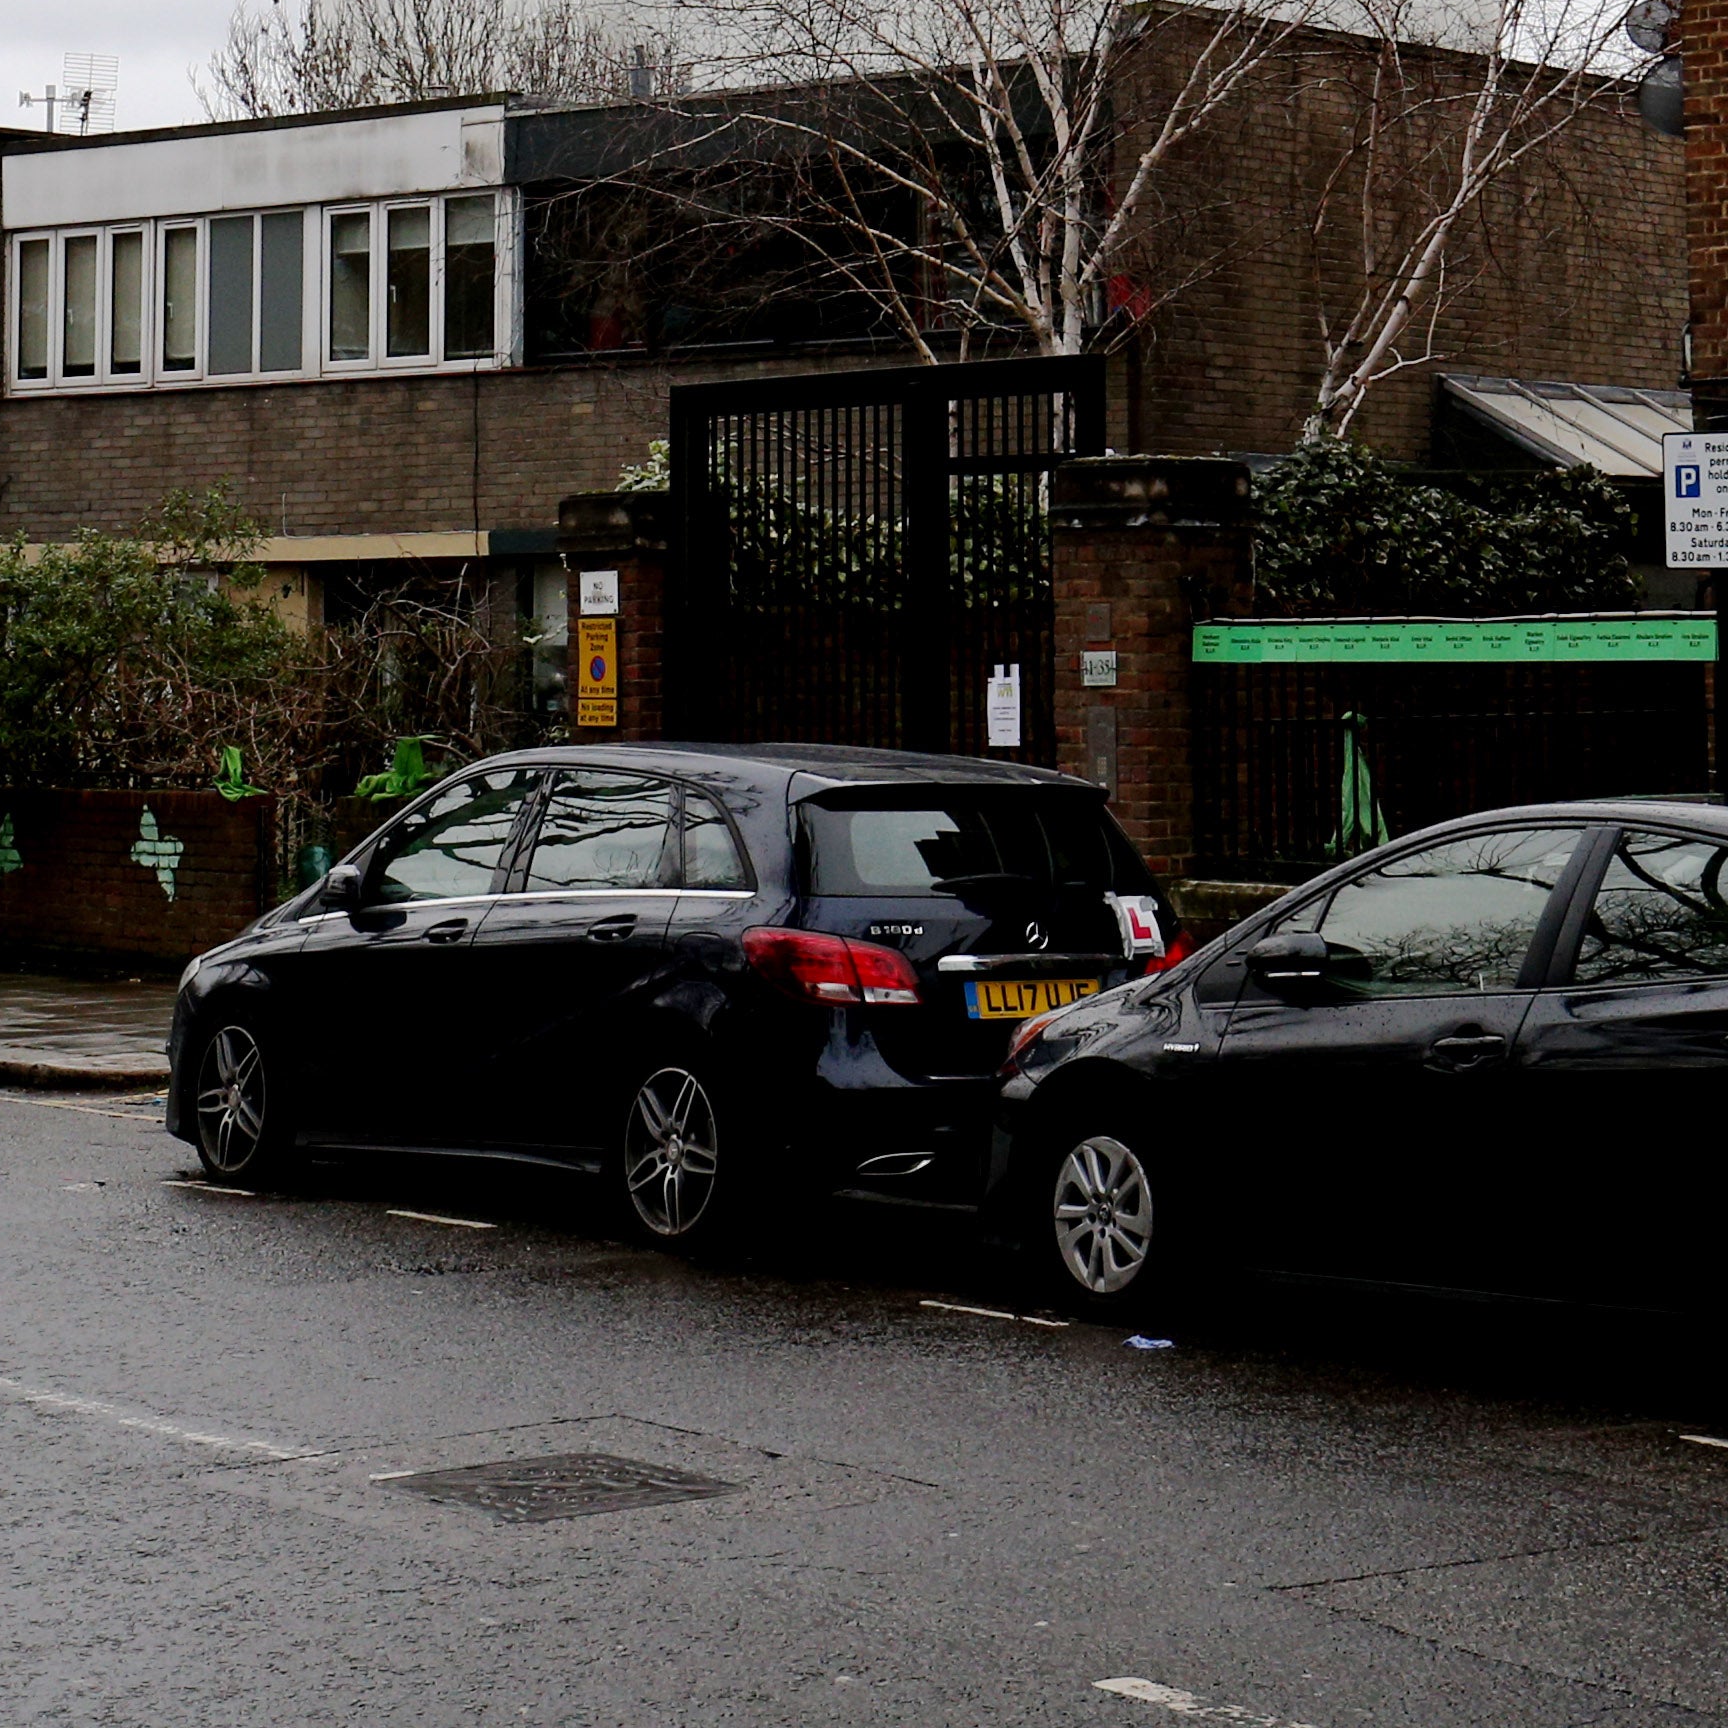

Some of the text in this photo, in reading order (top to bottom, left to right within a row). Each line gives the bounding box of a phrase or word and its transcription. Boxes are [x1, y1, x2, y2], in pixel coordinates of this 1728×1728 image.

[1681, 468, 1696, 496] P
[1692, 508, 1713, 518] Mon
[1670, 521, 1693, 532] 8.30
[1695, 524, 1709, 532] am
[1672, 551, 1694, 562] 8.30
[1696, 553, 1711, 562] am
[1128, 907, 1152, 940] L
[985, 984, 1037, 1012] LL17
